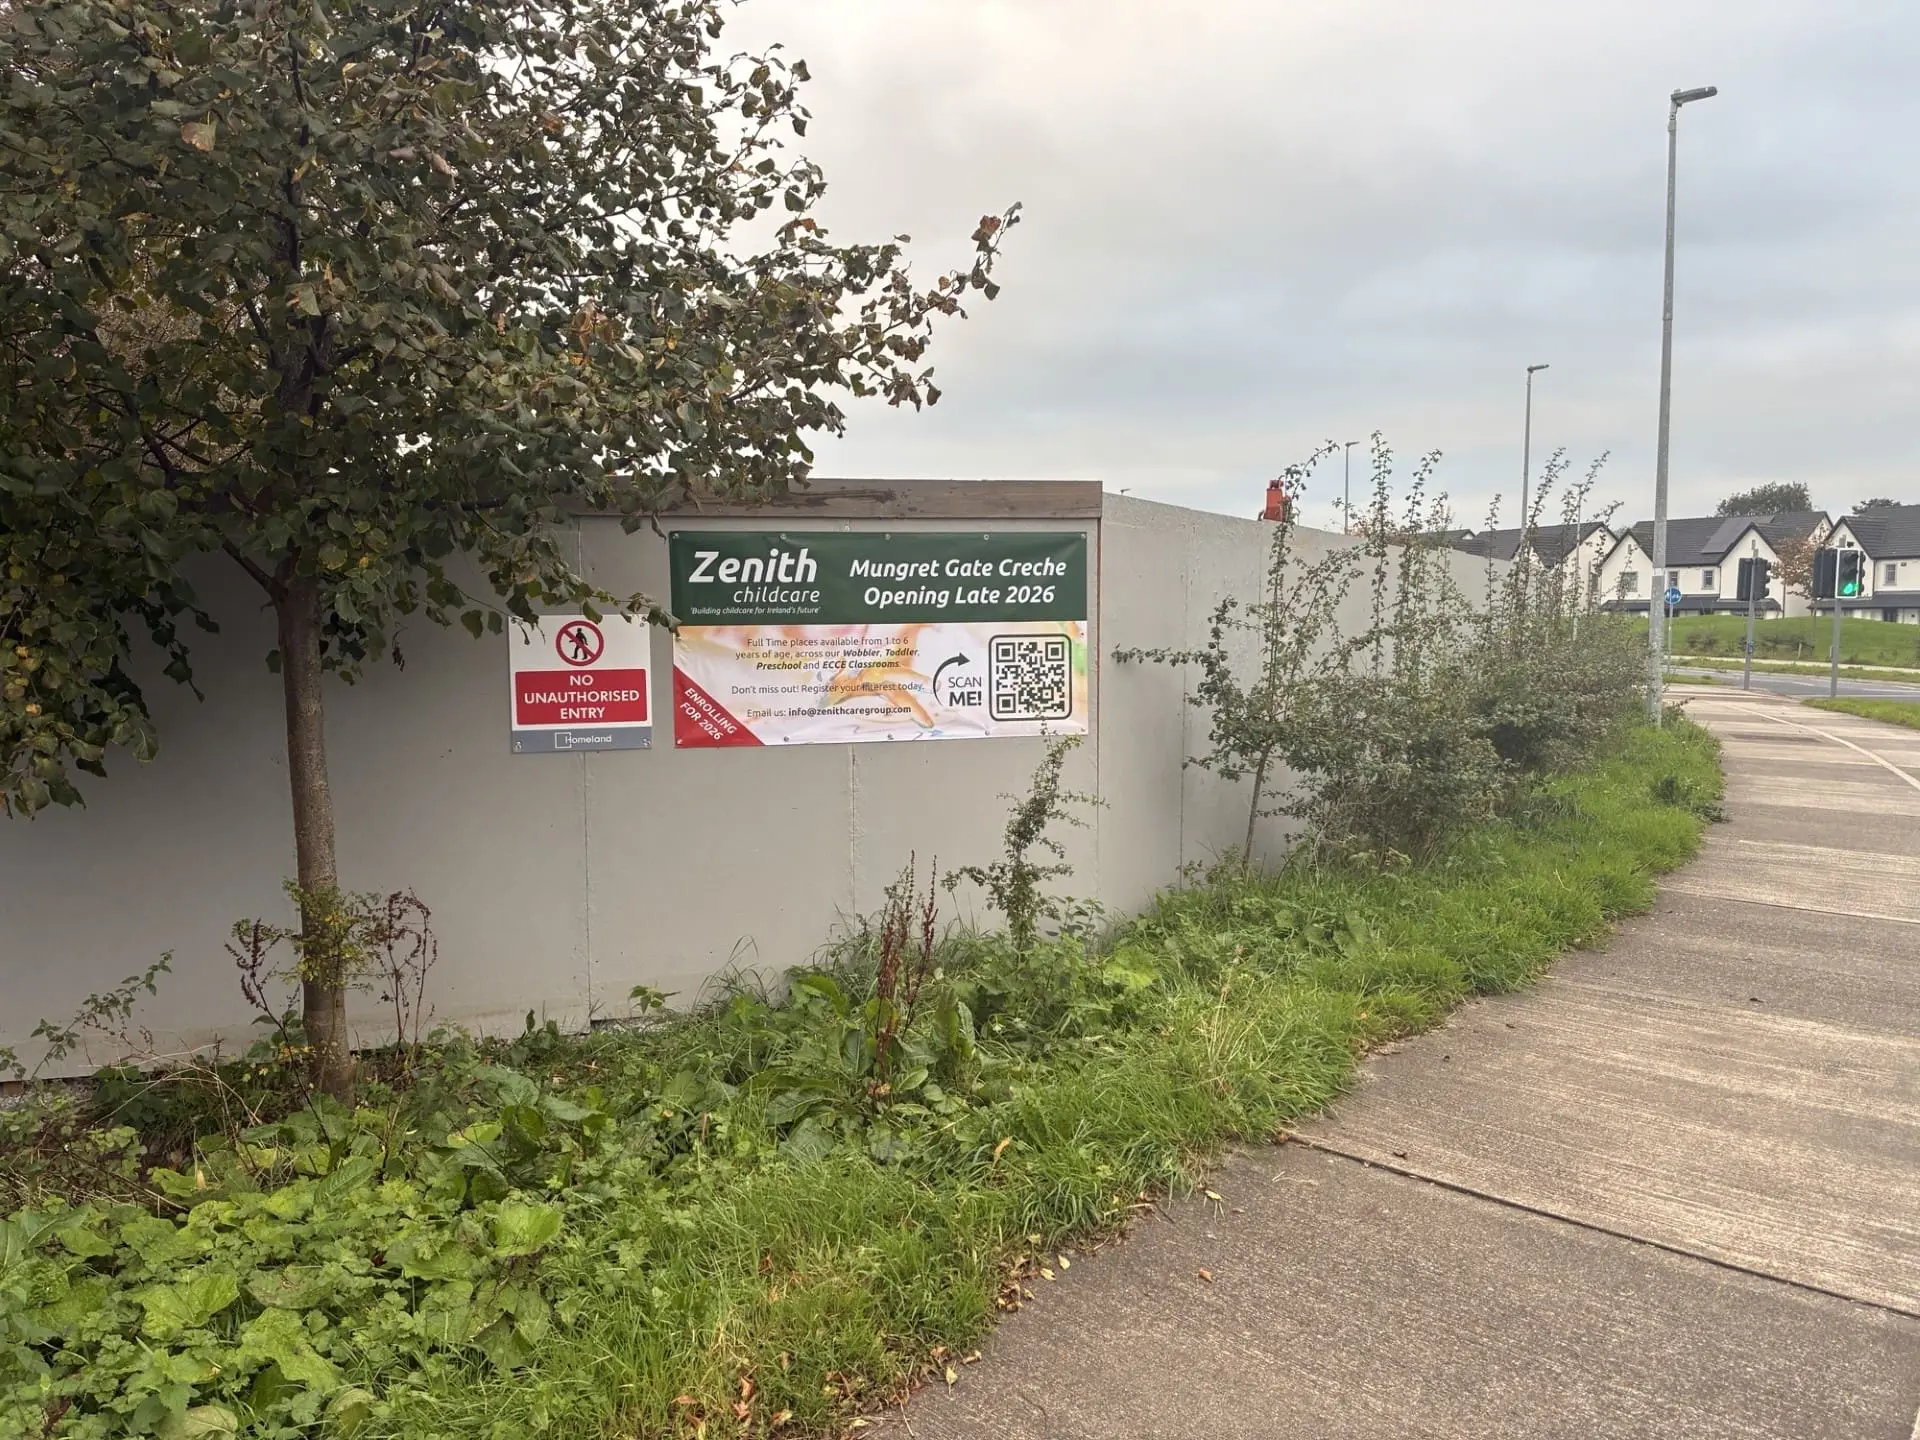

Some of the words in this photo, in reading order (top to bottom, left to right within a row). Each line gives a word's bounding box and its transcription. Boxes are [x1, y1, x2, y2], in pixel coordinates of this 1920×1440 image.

[688, 548, 818, 583] Zenith
[849, 558, 940, 581] Mungret
[945, 558, 993, 577] Gate
[998, 557, 1067, 577] Creche
[733, 586, 820, 603] childcare
[863, 586, 950, 608] Opening
[955, 586, 1001, 605] Late
[1005, 585, 1056, 603] 2026
[754, 606, 765, 615] for
[767, 606, 796, 614] Ireland's
[747, 638, 763, 647] Full
[765, 638, 788, 647] Time
[790, 638, 818, 648] places
[820, 637, 859, 646] available
[861, 637, 882, 646] from
[885, 637, 889, 645] 1
[891, 637, 901, 645] to
[903, 637, 908, 645] 6
[735, 651, 760, 660] years
[762, 649, 773, 658] of
[774, 651, 793, 660] age,
[795, 650, 823, 658] across
[825, 650, 840, 658] our
[843, 648, 882, 657] Wobbler,
[756, 661, 802, 670] Preschool
[803, 661, 820, 670] and
[823, 661, 846, 669] ECCE
[569, 674, 594, 686] NO
[948, 676, 982, 688] SCAN
[731, 685, 757, 694] Don't
[759, 685, 779, 694] miss
[780, 685, 799, 694] out!
[801, 684, 839, 694] Register
[840, 684, 860, 694] your
[898, 682, 925, 692] today.
[524, 690, 640, 704] UNAUTHORISED
[949, 691, 982, 707] ME!
[560, 707, 605, 720] ENTRY
[684, 687, 738, 735] ENROLLING
[747, 709, 772, 717] Email
[774, 709, 787, 717] us:
[788, 706, 911, 717] info@zenithcaregroup.com
[680, 702, 702, 721] FOR
[698, 719, 724, 740] 2026
[565, 734, 612, 744] Homeland
